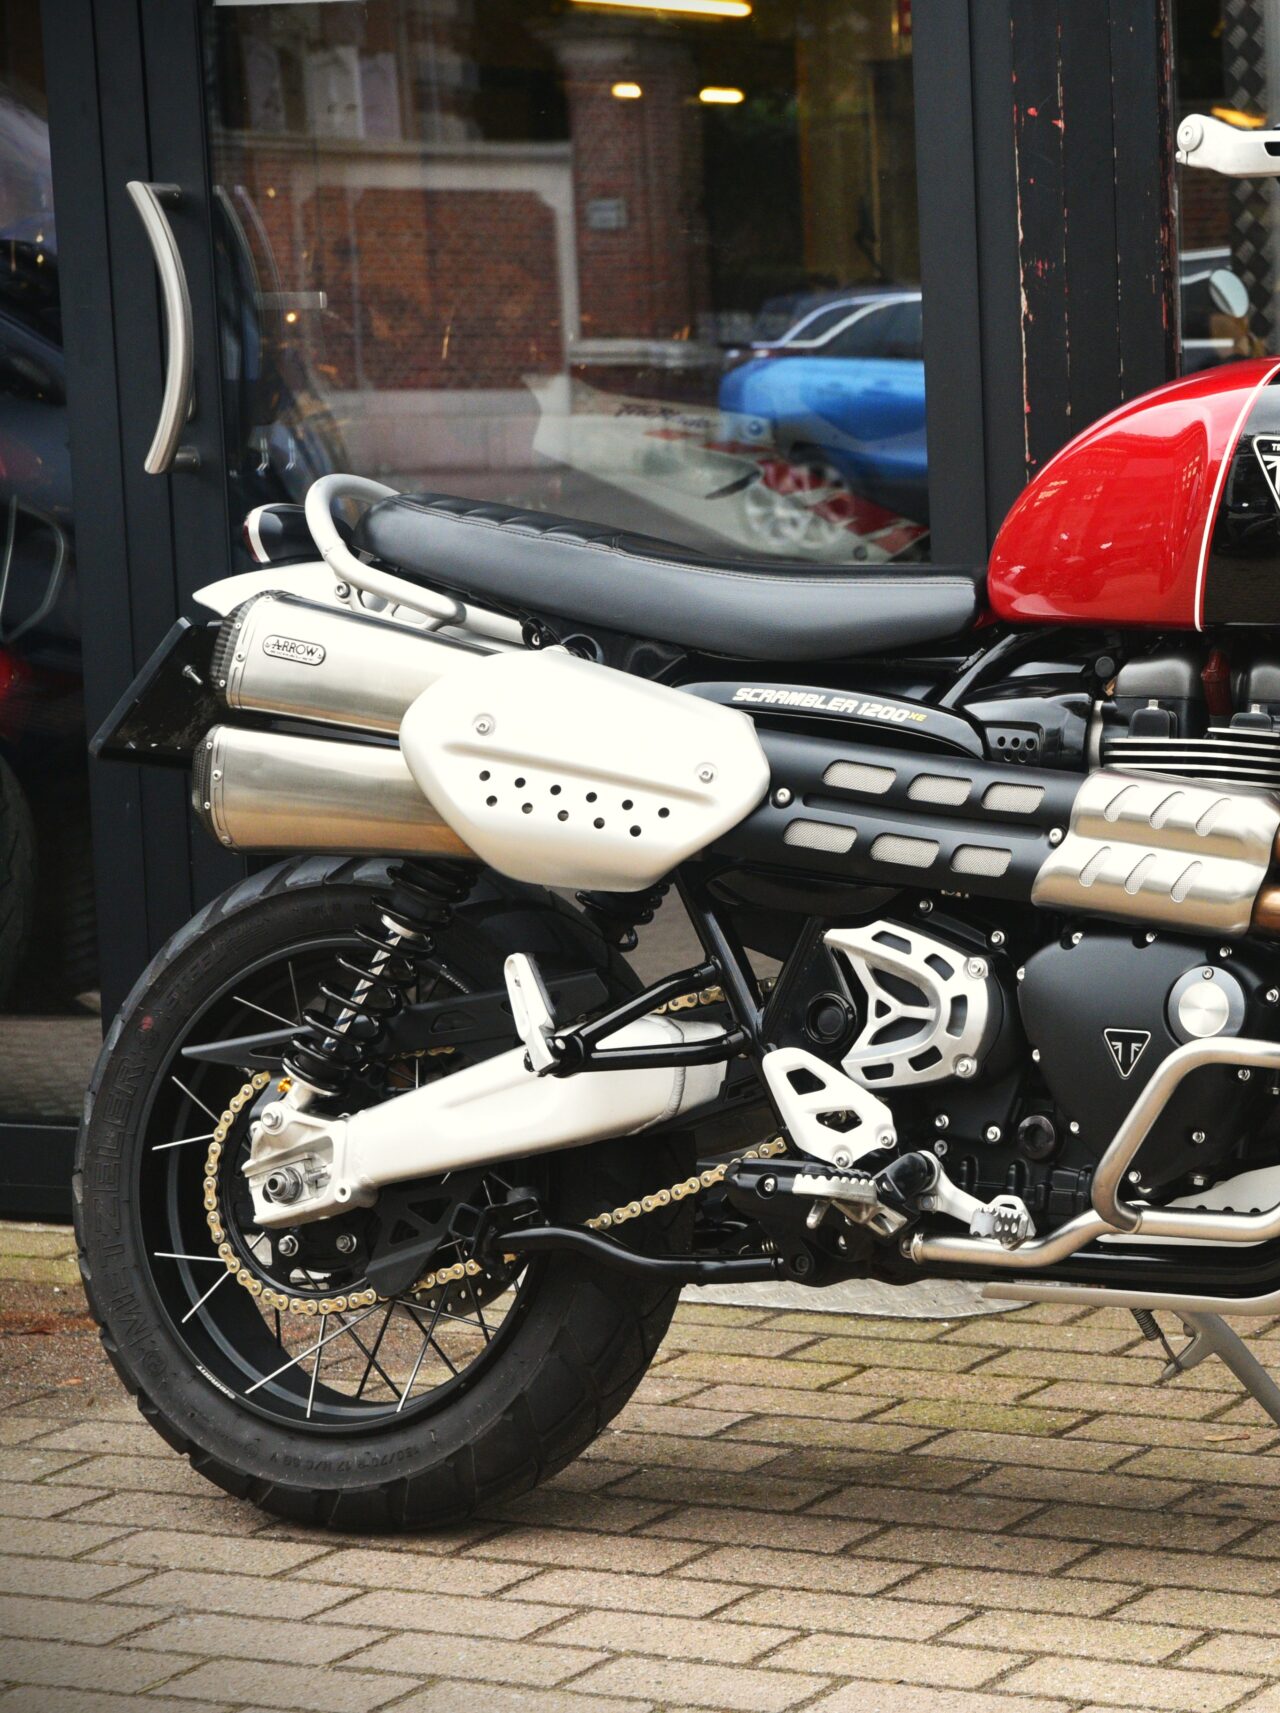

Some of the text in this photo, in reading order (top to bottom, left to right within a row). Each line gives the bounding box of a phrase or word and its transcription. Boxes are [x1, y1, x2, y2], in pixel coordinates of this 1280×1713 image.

[271, 639, 319, 657] ARROW
[732, 687, 929, 723] SCRAMBLER 1200 XE
[92, 1058, 153, 1349] METZELER
